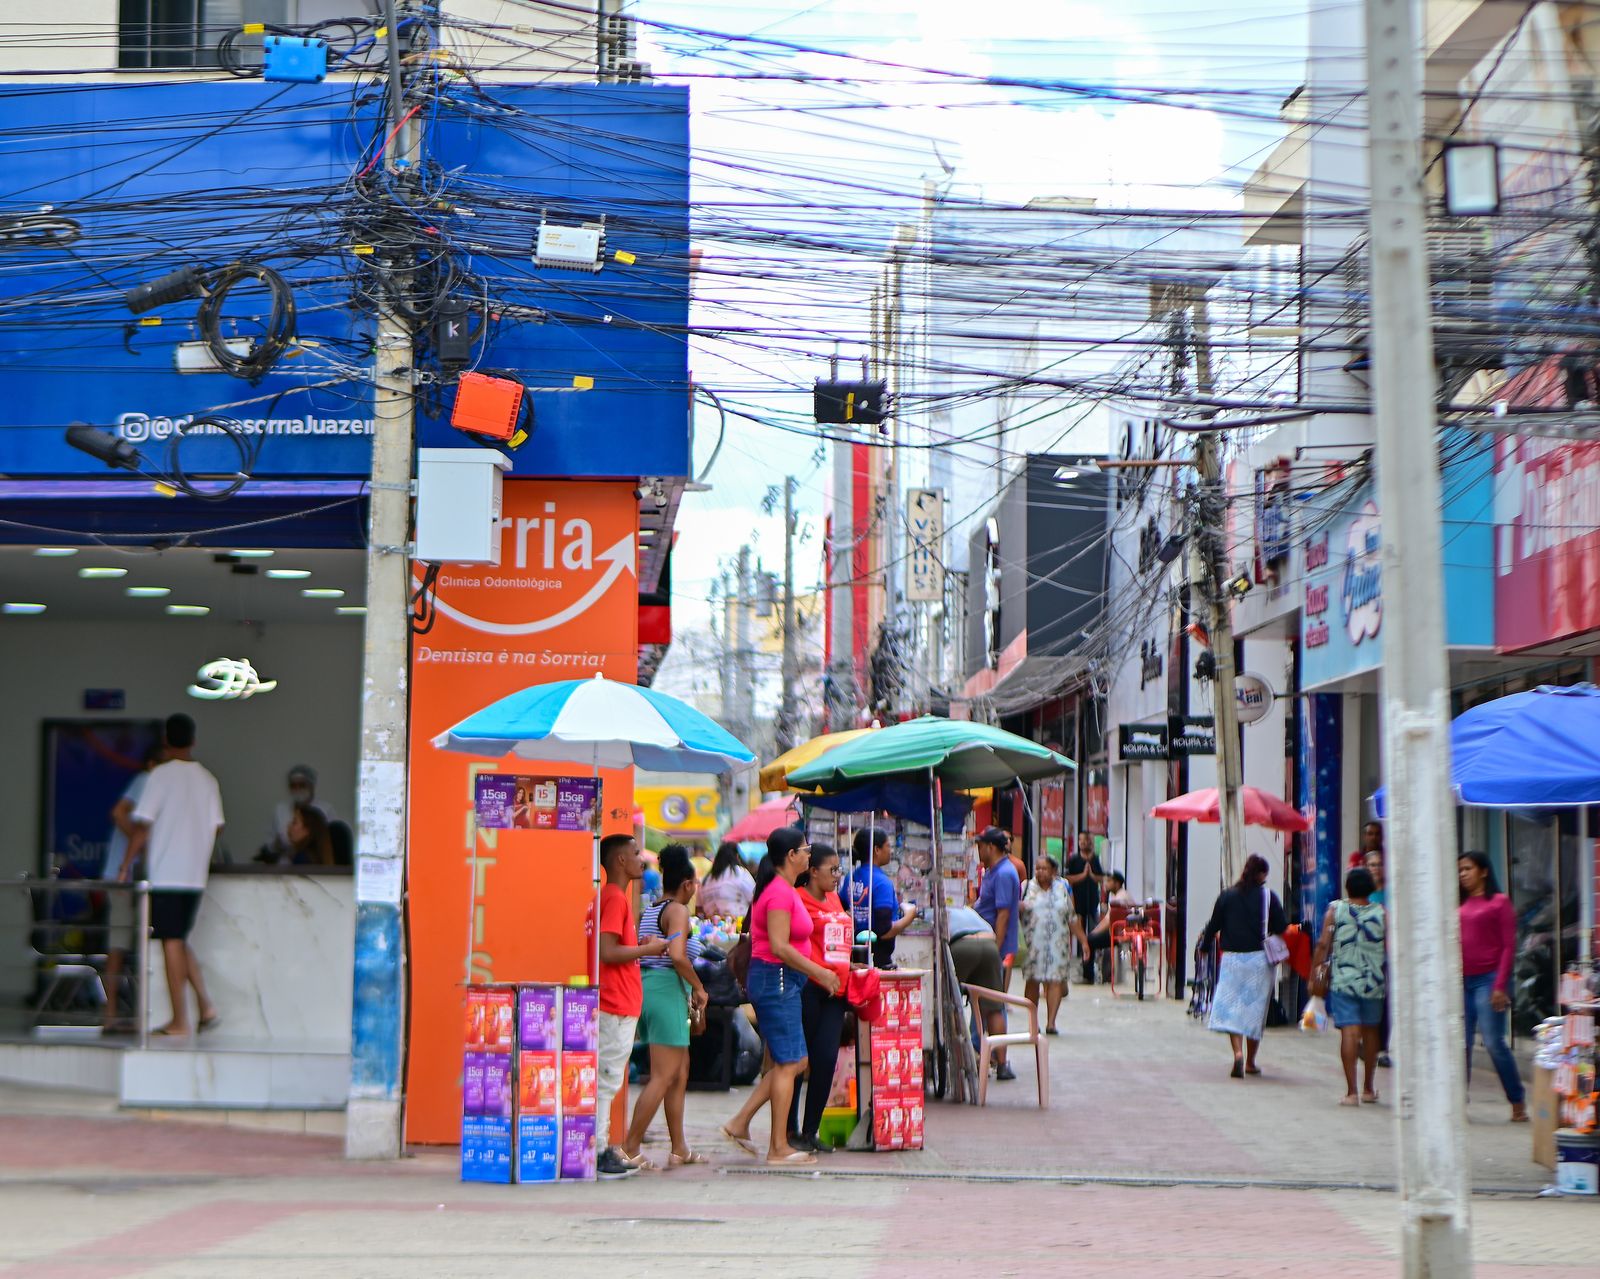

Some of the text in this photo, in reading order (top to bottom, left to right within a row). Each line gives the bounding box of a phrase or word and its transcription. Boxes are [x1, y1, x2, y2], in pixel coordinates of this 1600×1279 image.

[484, 577, 562, 591] Odontológica
[417, 647, 494, 664] Dentista
[513, 652, 536, 665] na
[540, 651, 607, 667] Sorria!
[482, 789, 507, 800] 15GB
[559, 791, 584, 803] 15GB
